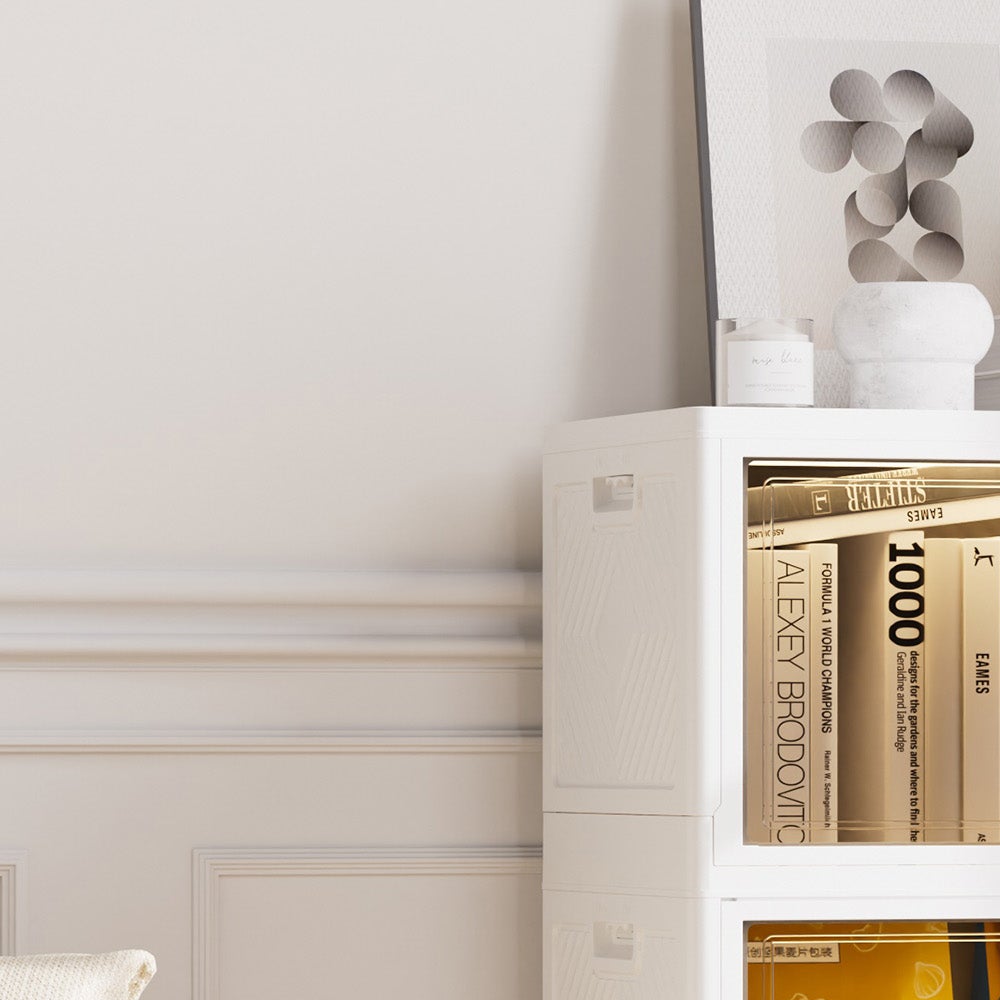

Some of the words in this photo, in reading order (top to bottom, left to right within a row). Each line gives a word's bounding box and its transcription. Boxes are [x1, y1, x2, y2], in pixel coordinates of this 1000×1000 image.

[907, 507, 943, 522] EAMES
[821, 562, 833, 615] FORMULA
[889, 542, 925, 647] 1000
[777, 560, 805, 671] ALEXEY
[821, 626, 833, 667] WORLD
[897, 651, 907, 692] Geraldine
[908, 650, 919, 683] designs
[975, 653, 990, 694] EAMES
[821, 668, 833, 734] CHAMPIONS
[897, 693, 907, 709] and
[910, 685, 919, 698] for
[910, 699, 919, 714] the
[897, 710, 907, 724] Ian
[895, 726, 907, 752] Rudge
[908, 715, 919, 750] gardens
[910, 751, 920, 767] and
[910, 769, 920, 796] where
[910, 797, 920, 807] to
